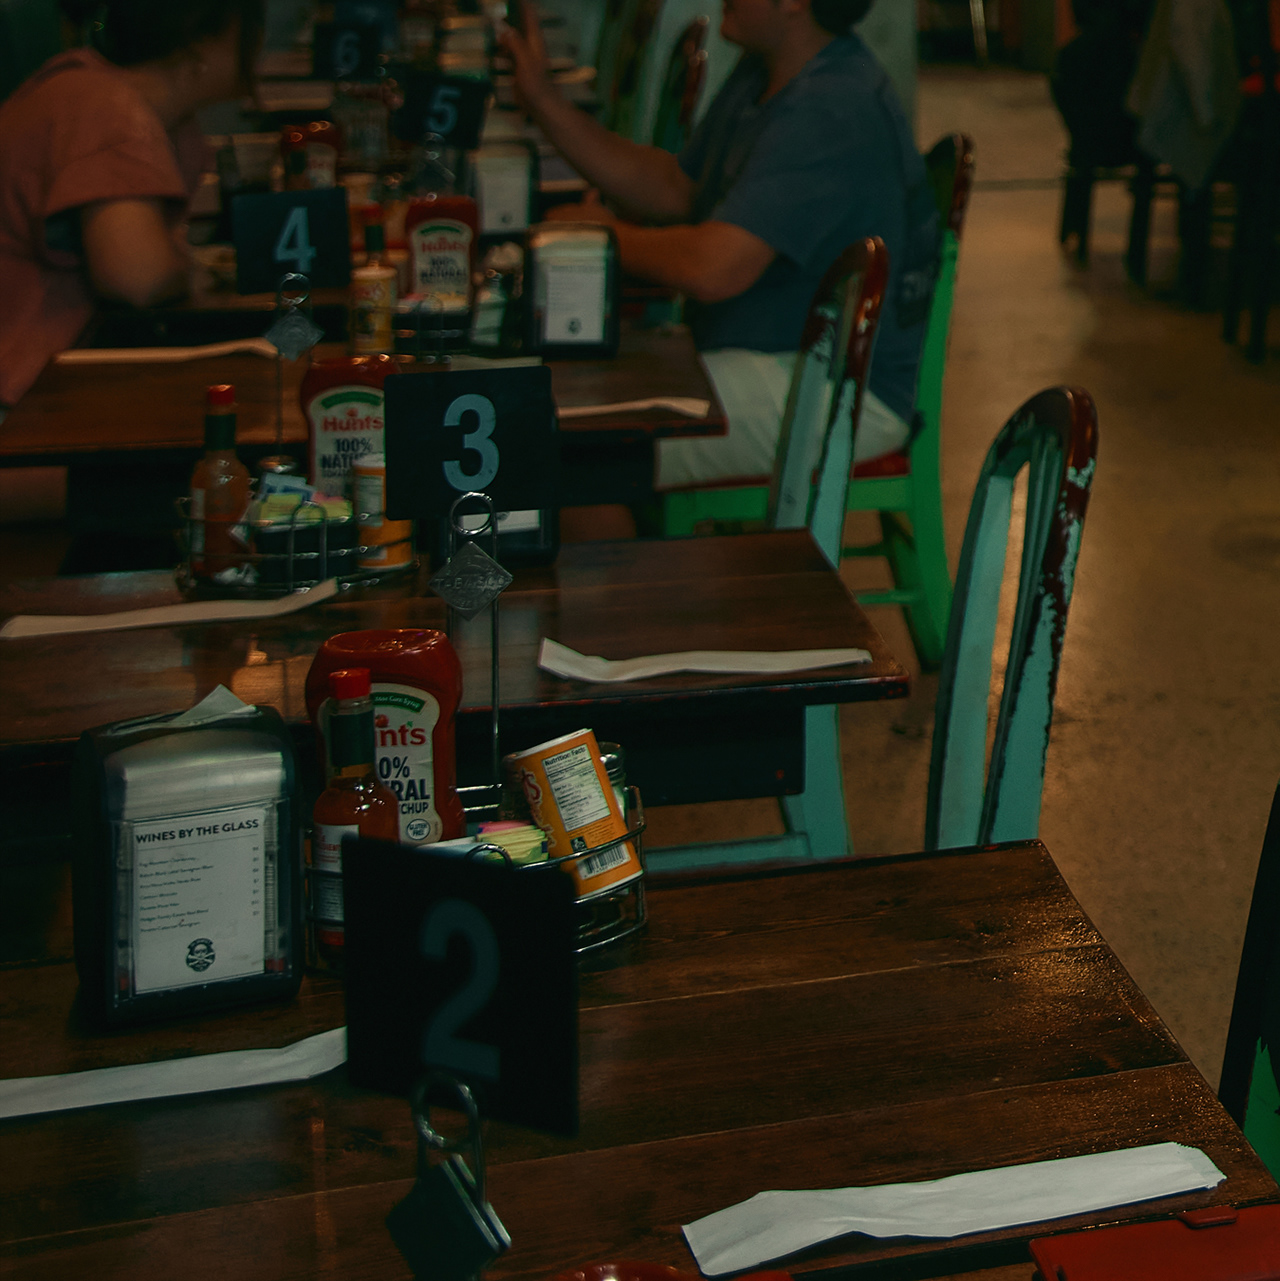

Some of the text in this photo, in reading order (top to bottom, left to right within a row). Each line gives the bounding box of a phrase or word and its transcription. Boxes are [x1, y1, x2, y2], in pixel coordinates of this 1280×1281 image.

[424, 84, 462, 136] 5
[272, 205, 317, 272] 4
[334, 437, 374, 453] 100%
[442, 393, 500, 492] 3
[374, 721, 426, 748] nt's
[378, 756, 410, 780] 0%
[136, 819, 259, 843] WINES BY THE GLASS
[421, 898, 500, 1079] 2
